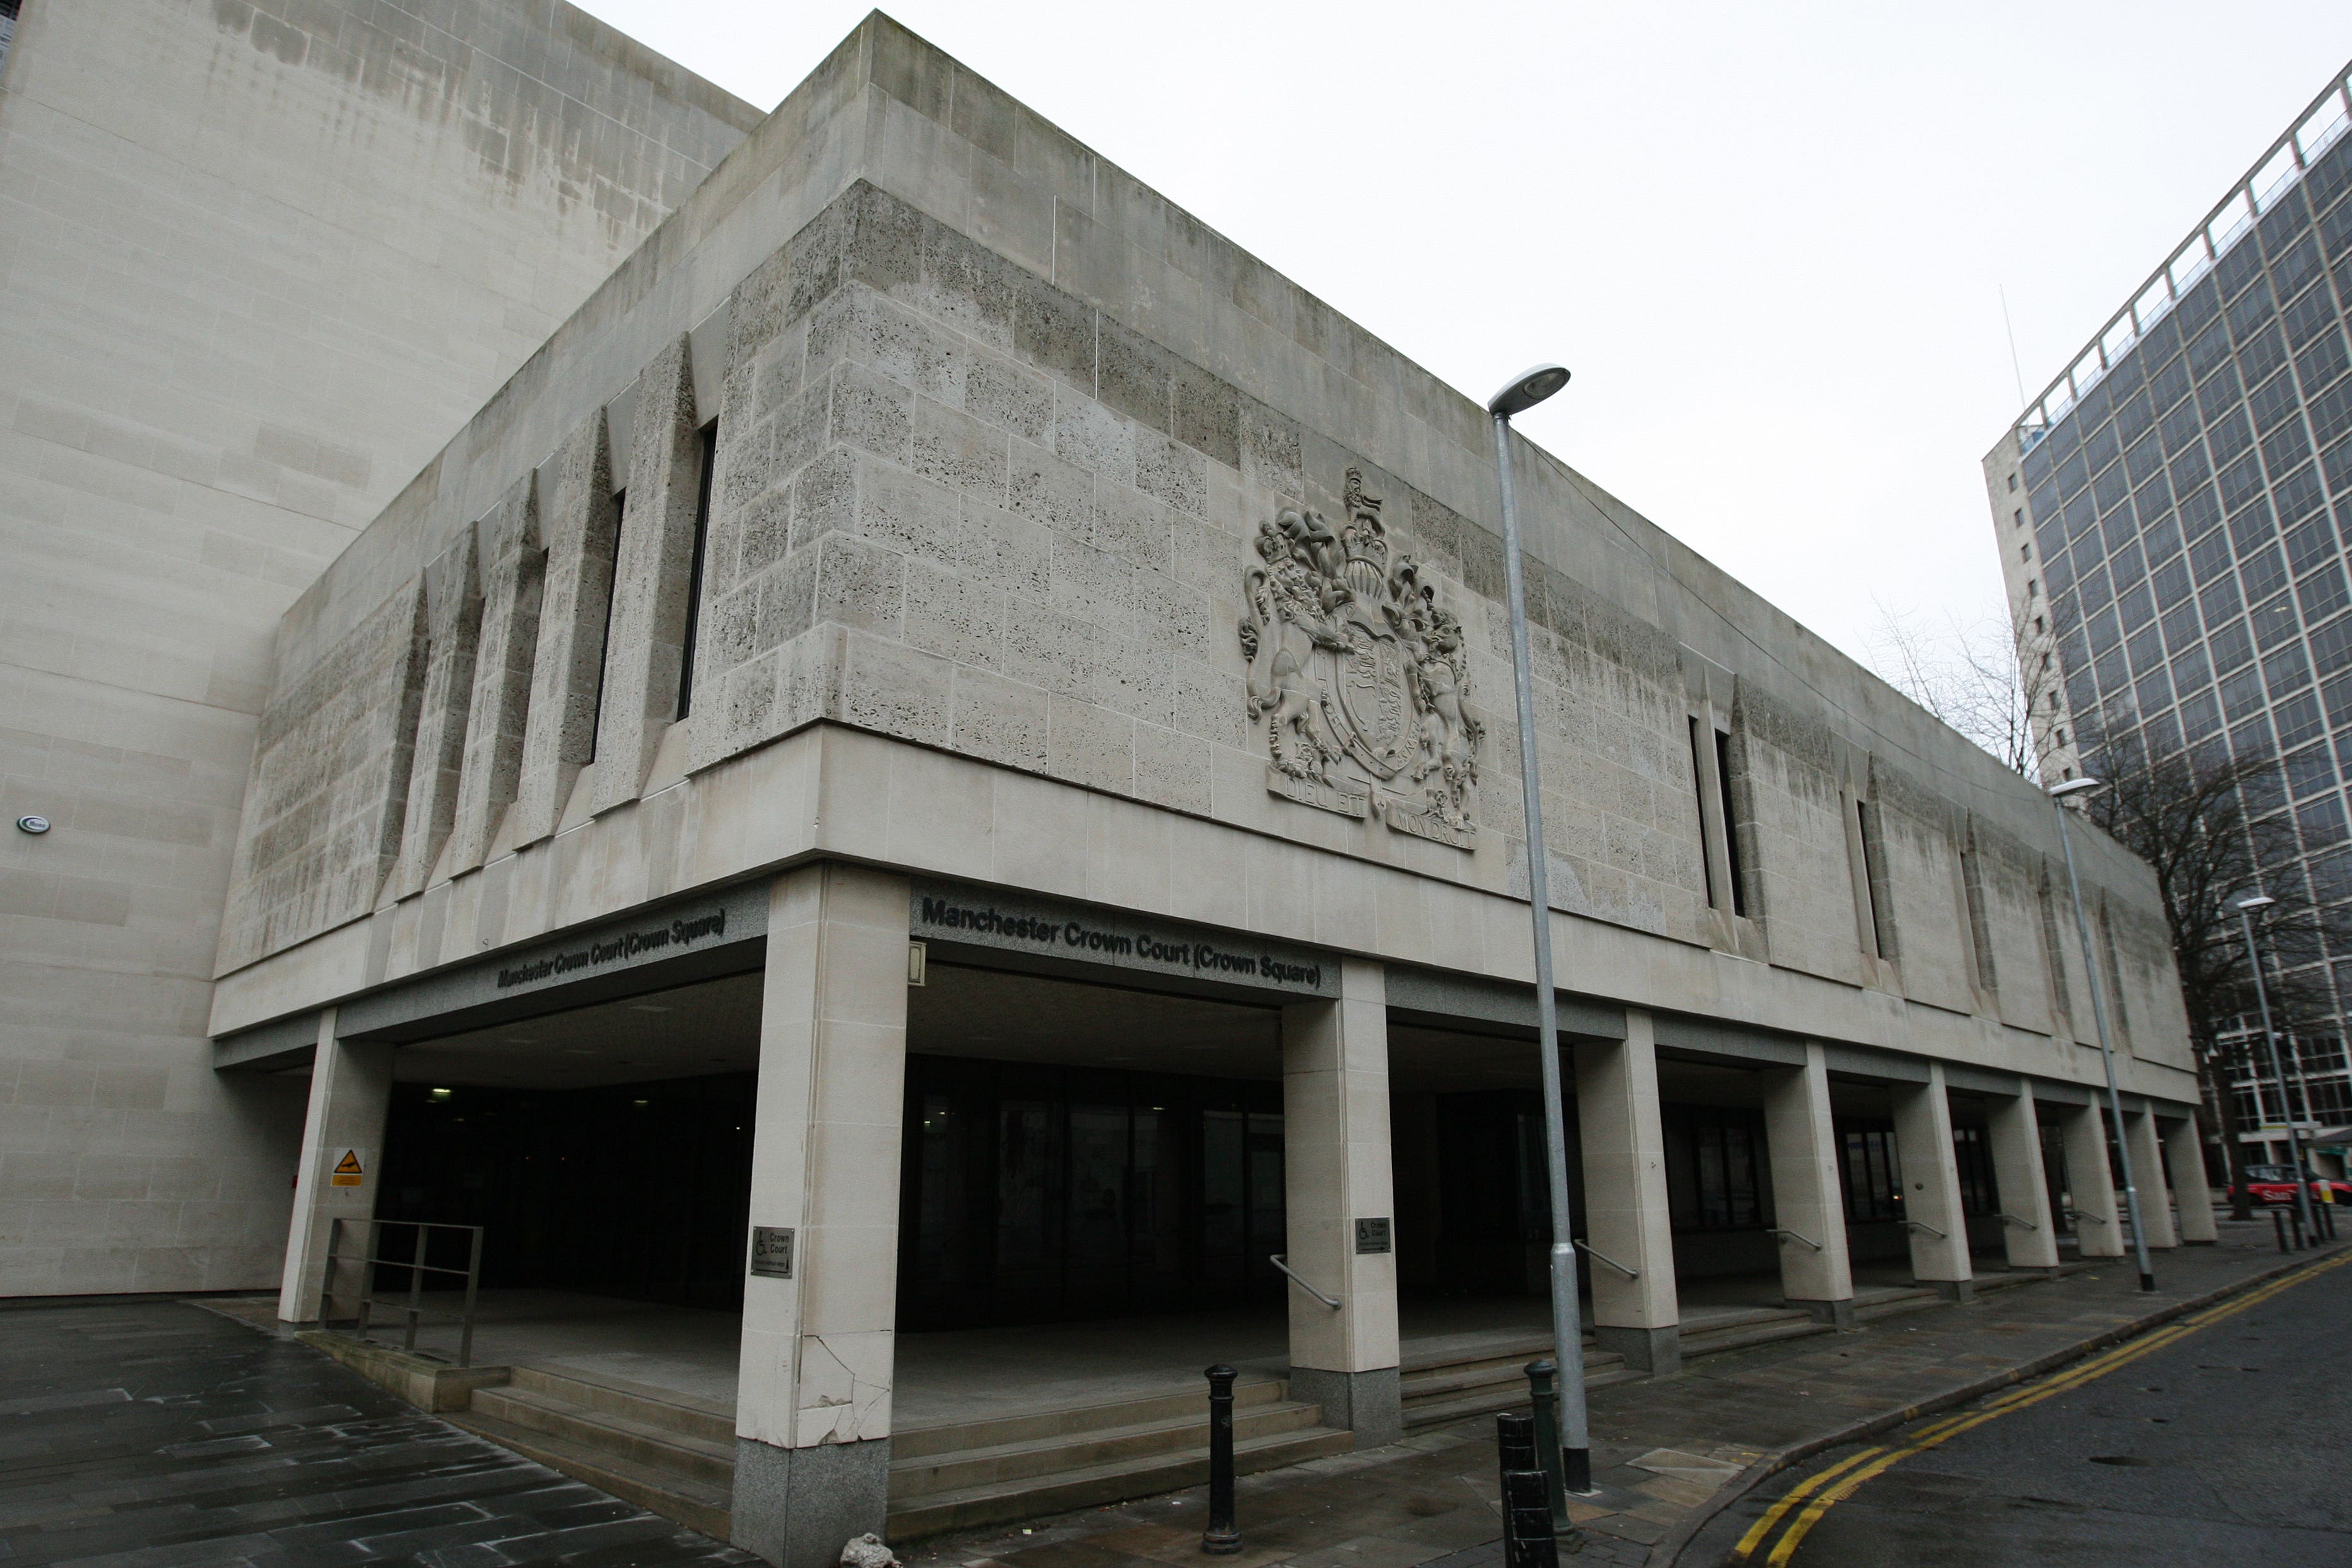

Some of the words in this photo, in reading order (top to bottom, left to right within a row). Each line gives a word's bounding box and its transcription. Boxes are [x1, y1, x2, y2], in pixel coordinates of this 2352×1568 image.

[1285, 775, 1328, 808] DIEU
[1397, 812, 1427, 837] MON
[1431, 821, 1476, 848] DROIT
[497, 960, 555, 989] Manchester
[554, 951, 588, 974] Crown
[589, 937, 623, 965] Court
[623, 928, 670, 961] (Crown
[671, 908, 726, 946] Square)
[922, 897, 1060, 942] Manchester
[1065, 922, 1131, 955] Crown
[1137, 934, 1191, 964] Court
[1193, 943, 1256, 974] (Crown
[1260, 955, 1321, 988] Square)
[769, 1232, 789, 1243] Crown
[770, 1244, 788, 1254] Court
